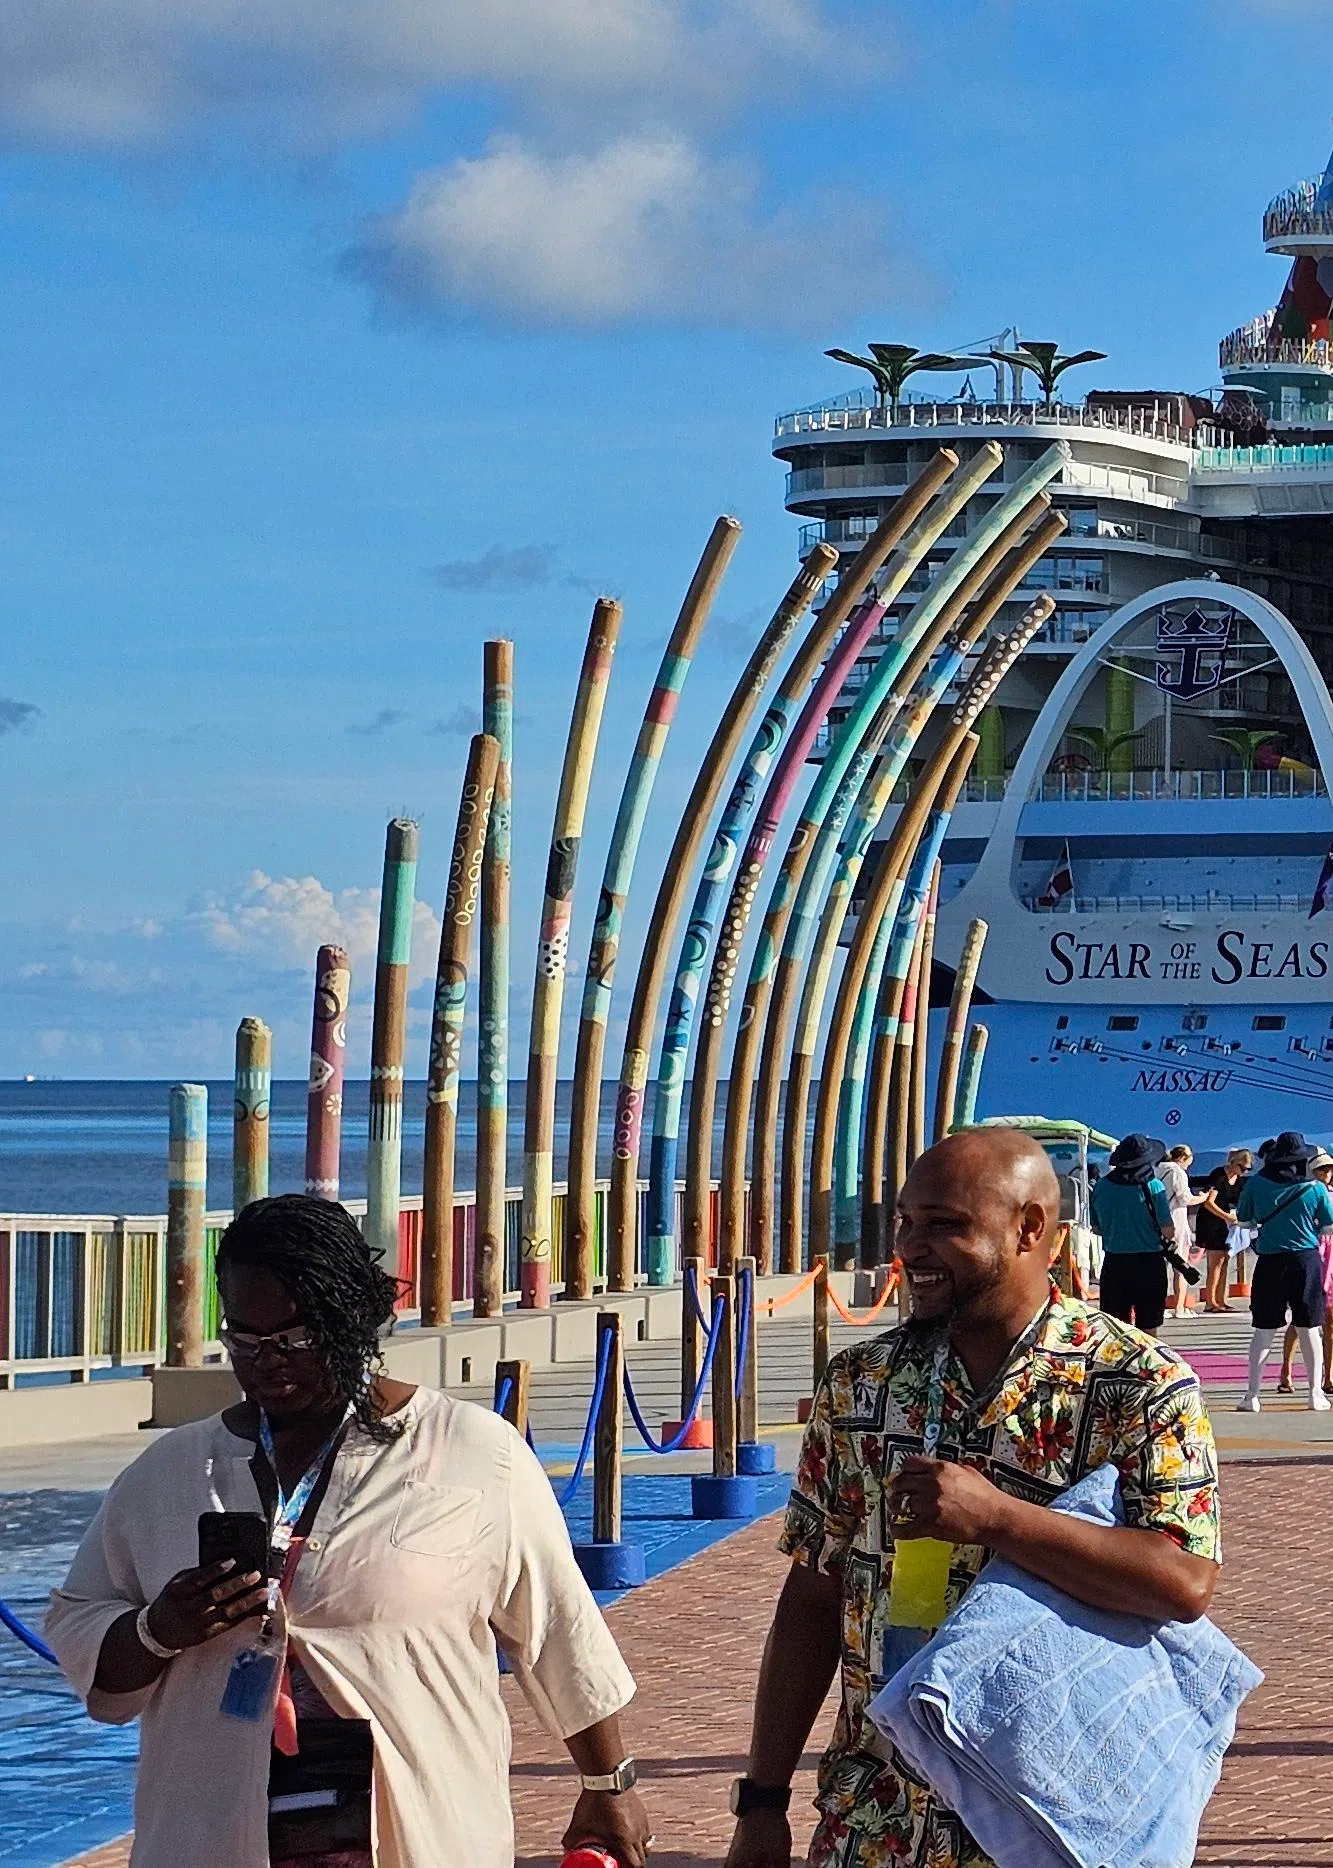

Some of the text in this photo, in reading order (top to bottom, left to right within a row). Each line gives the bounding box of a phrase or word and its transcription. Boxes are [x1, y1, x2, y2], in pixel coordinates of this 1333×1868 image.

[1045, 930, 1330, 986] STAR OF THE SEAS
[1131, 1069, 1234, 1093] NASSAU
